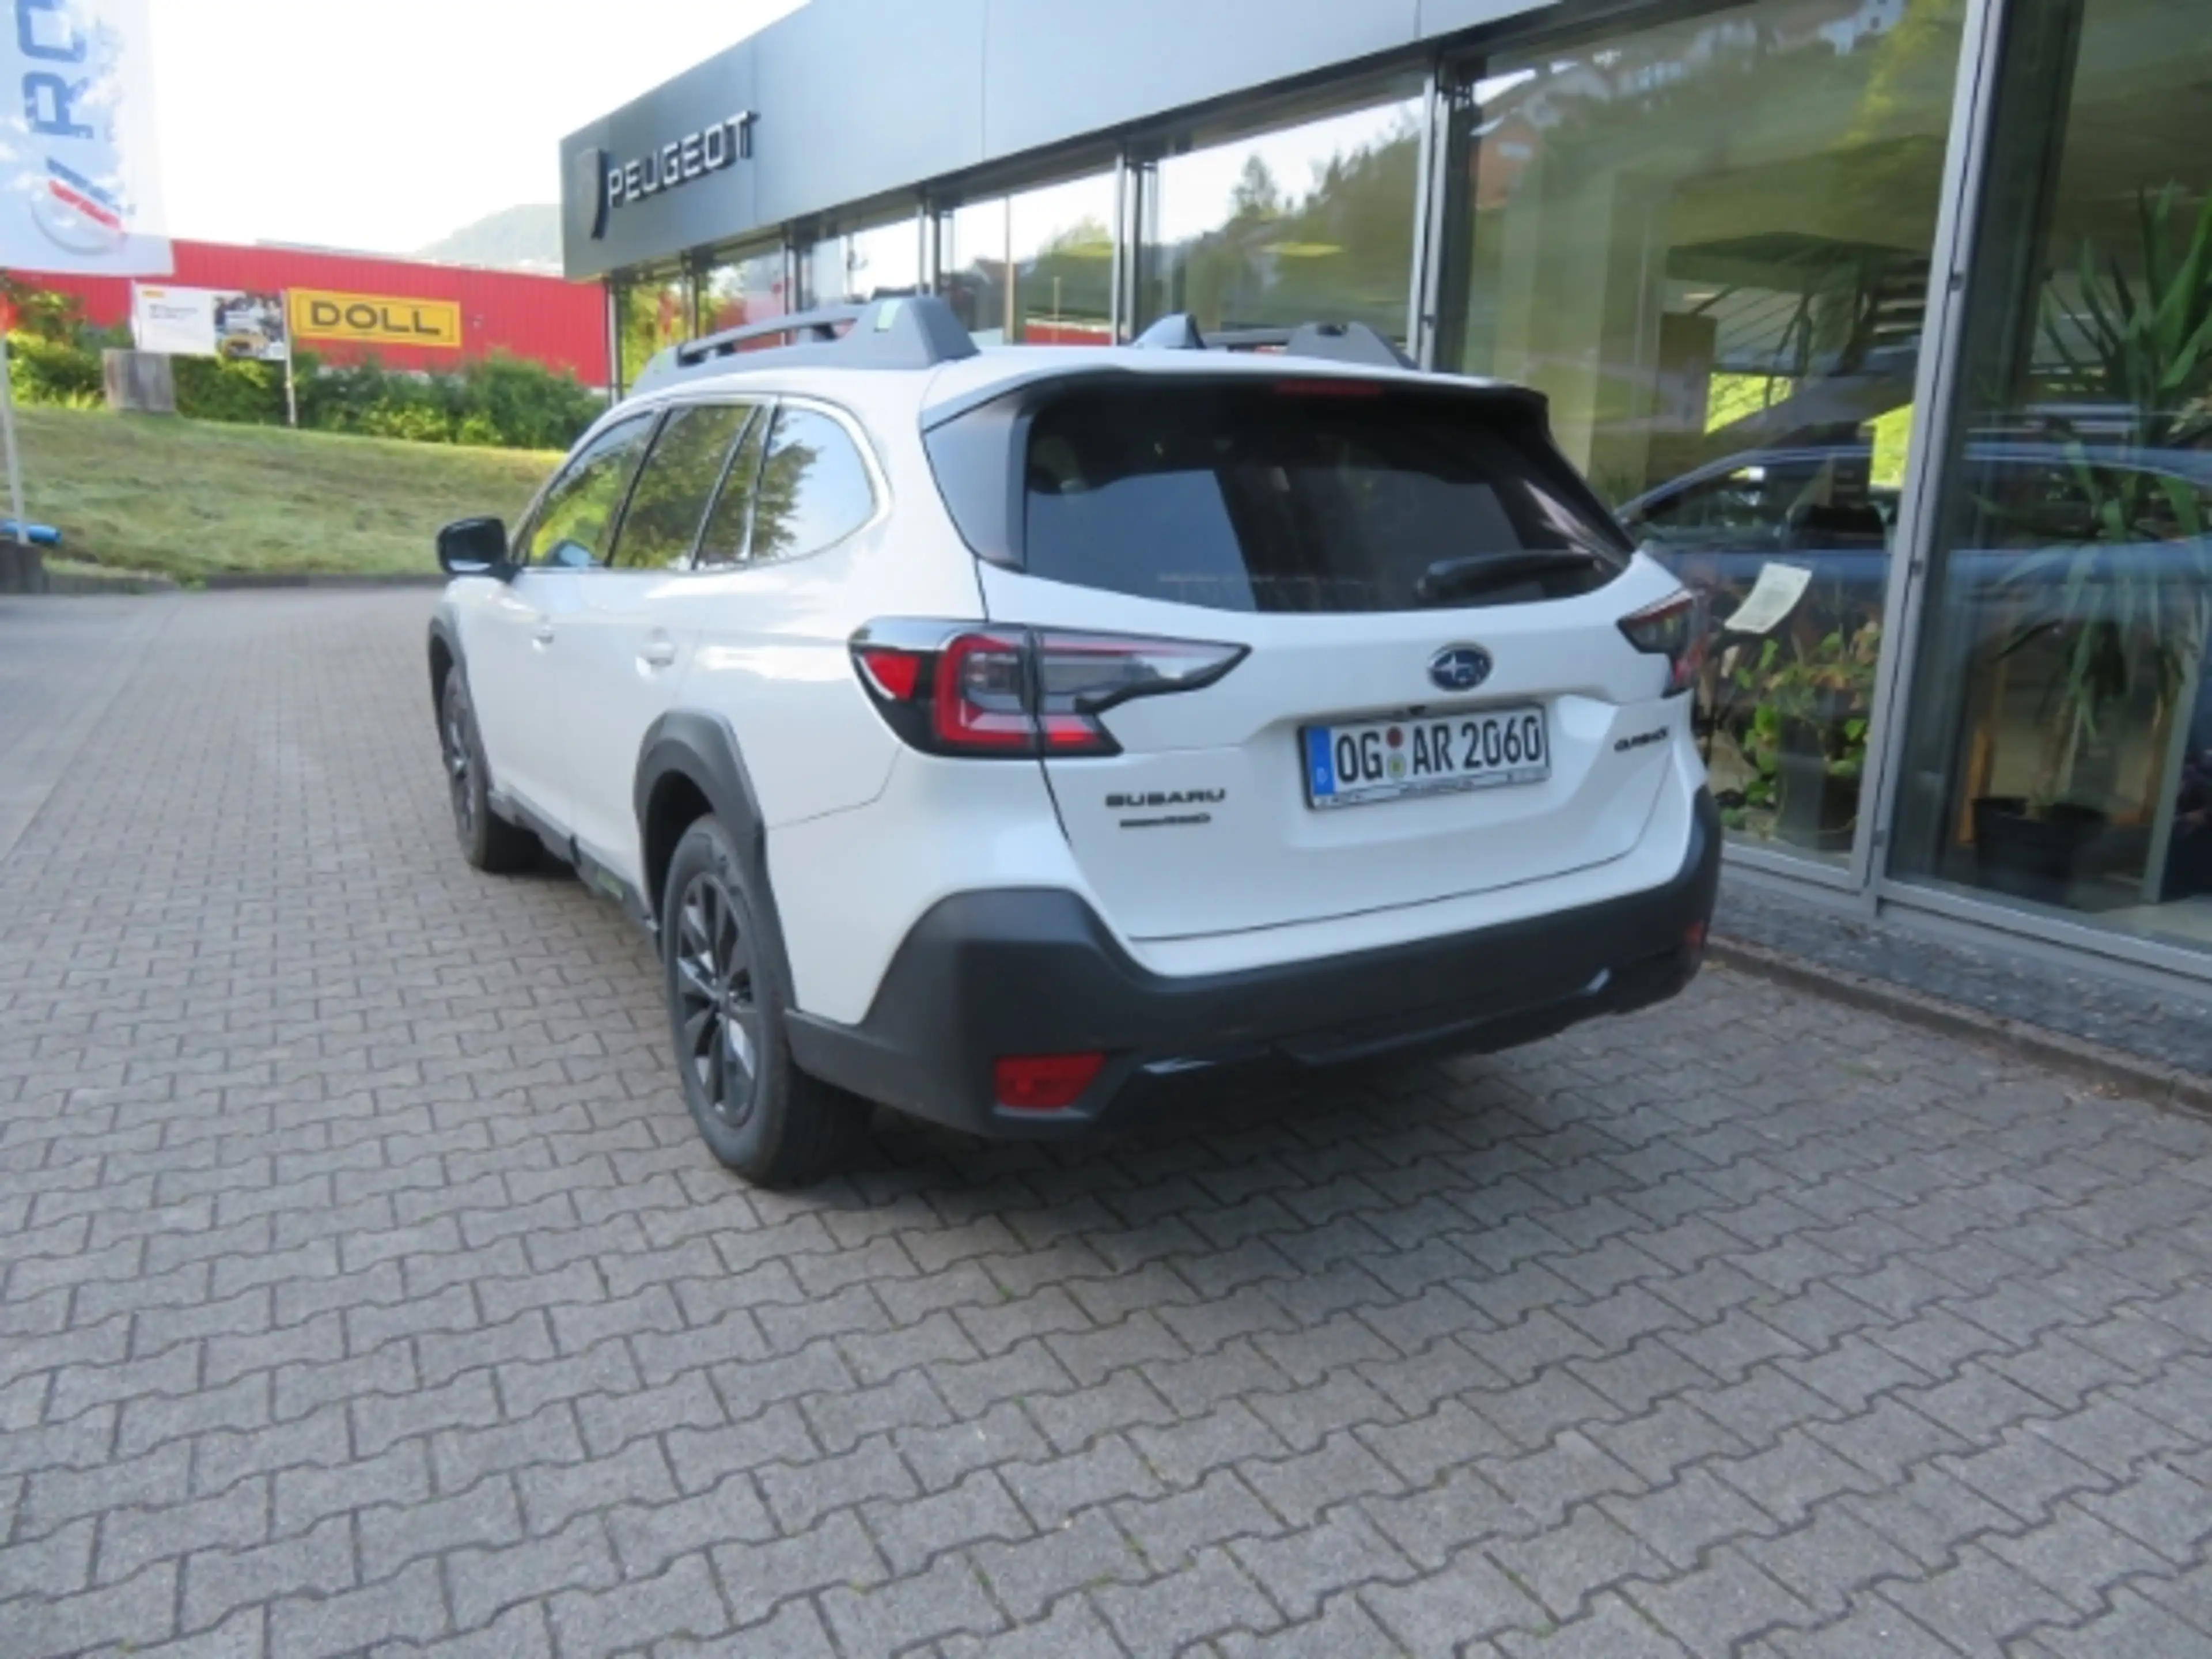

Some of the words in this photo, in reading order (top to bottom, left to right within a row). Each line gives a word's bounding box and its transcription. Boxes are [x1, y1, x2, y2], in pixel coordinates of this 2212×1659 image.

[607, 110, 755, 209] PEUGEOT
[311, 301, 441, 336] DOLL
[1336, 732, 1383, 784] OG
[1412, 724, 1454, 775] AR
[1461, 715, 1543, 769] 2060
